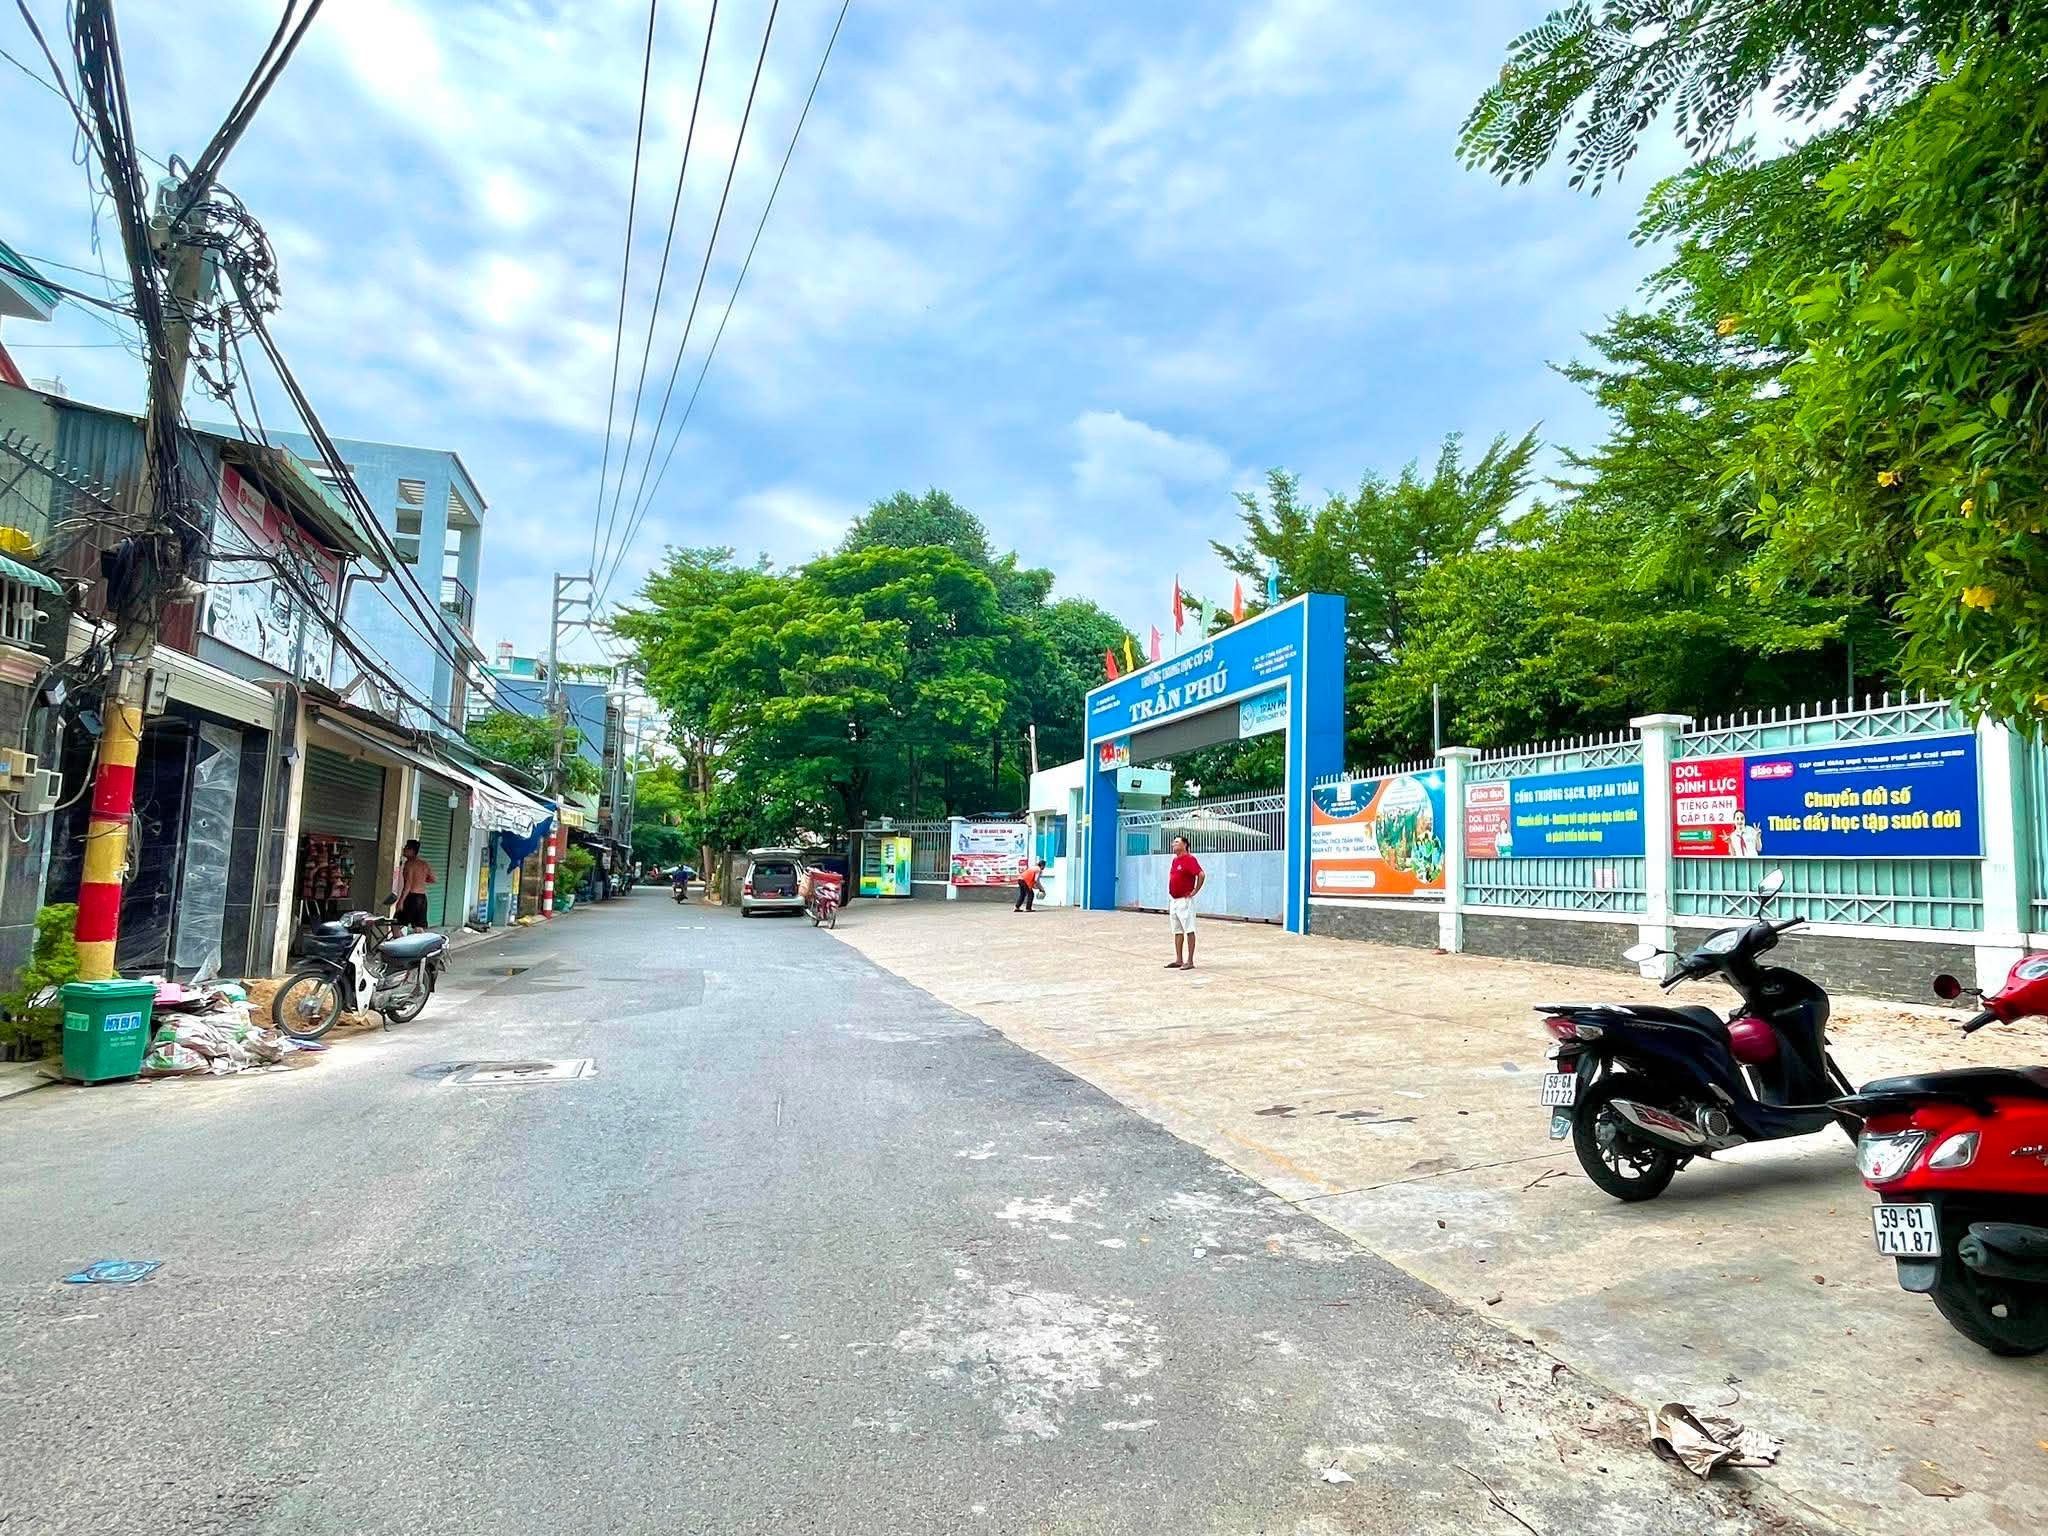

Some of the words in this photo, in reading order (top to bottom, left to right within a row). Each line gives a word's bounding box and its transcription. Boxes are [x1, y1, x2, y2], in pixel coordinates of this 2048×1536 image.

[1129, 683, 1182, 723] TRẦN
[1184, 660, 1229, 705] PHÚ
[1676, 765, 1702, 779] DOL
[1675, 779, 1706, 794] ĐÌNH
[1708, 776, 1737, 794] LỰC
[1712, 800, 1732, 809] ANH
[1804, 788, 1860, 808] Chuyển
[1862, 786, 1888, 806] đổi
[1890, 786, 1912, 804] số
[1709, 814, 1716, 822] &
[1718, 813, 1724, 821] 2
[1768, 815, 1801, 831] Thúc
[1831, 814, 1860, 834] học
[1862, 812, 1888, 834] tập
[1891, 810, 1930, 829] suốt
[1932, 810, 1961, 828] đời
[1880, 1208, 1923, 1228] 59-G1
[1879, 1231, 1932, 1252] 741.87
